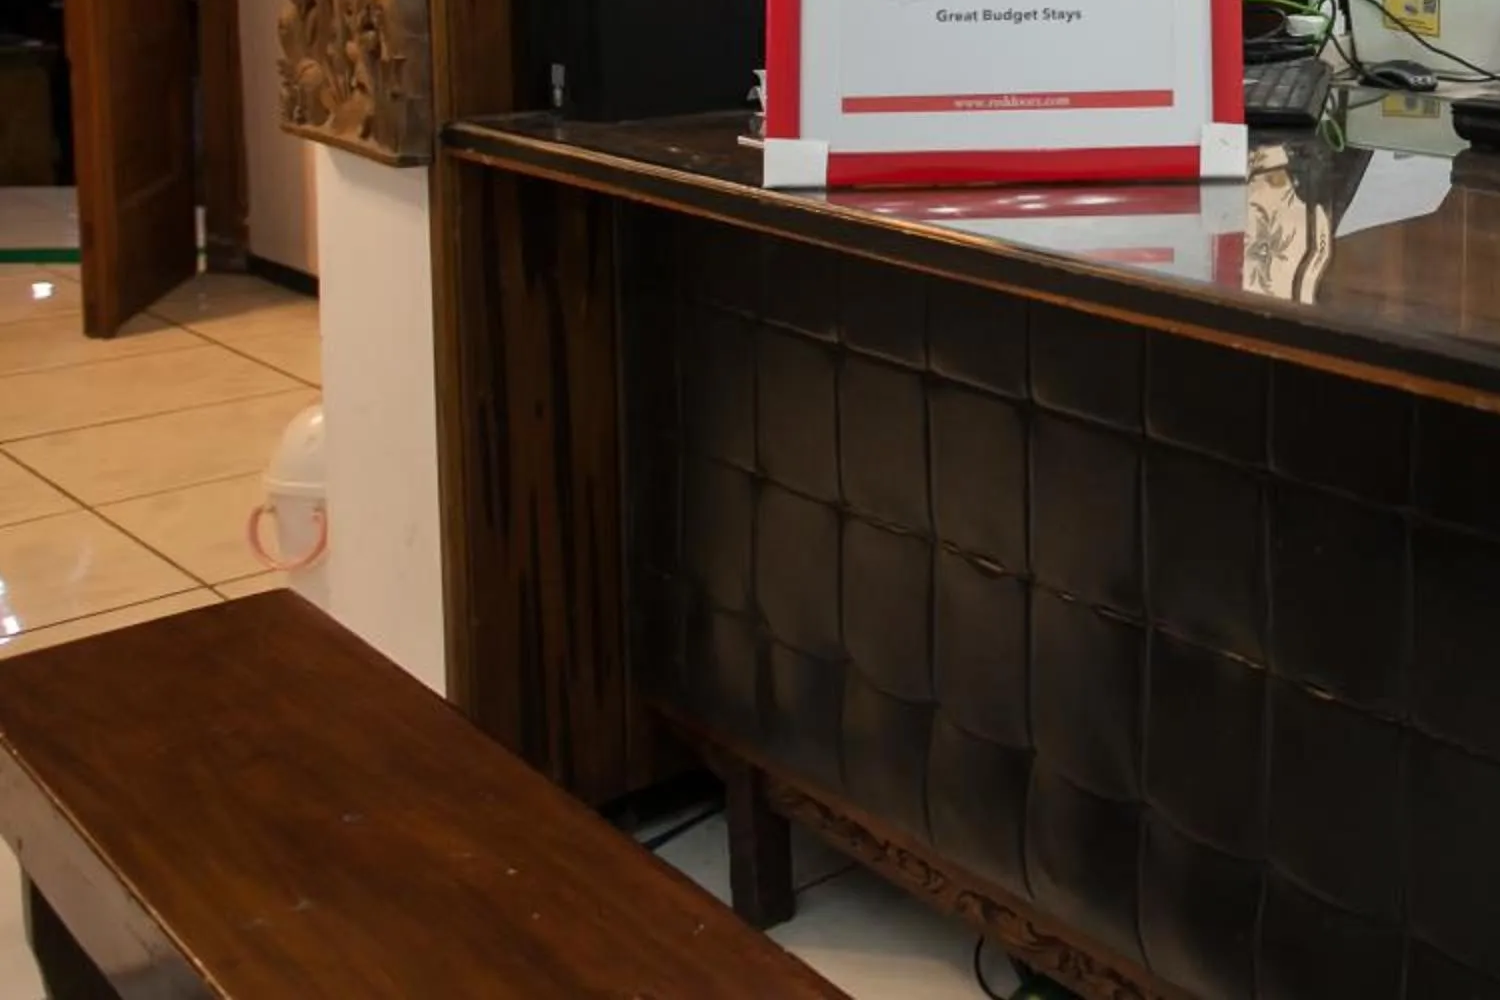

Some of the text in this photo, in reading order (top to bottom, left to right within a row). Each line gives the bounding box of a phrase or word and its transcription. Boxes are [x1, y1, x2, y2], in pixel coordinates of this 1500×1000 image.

[935, 7, 1082, 24] Great Budget Stays
